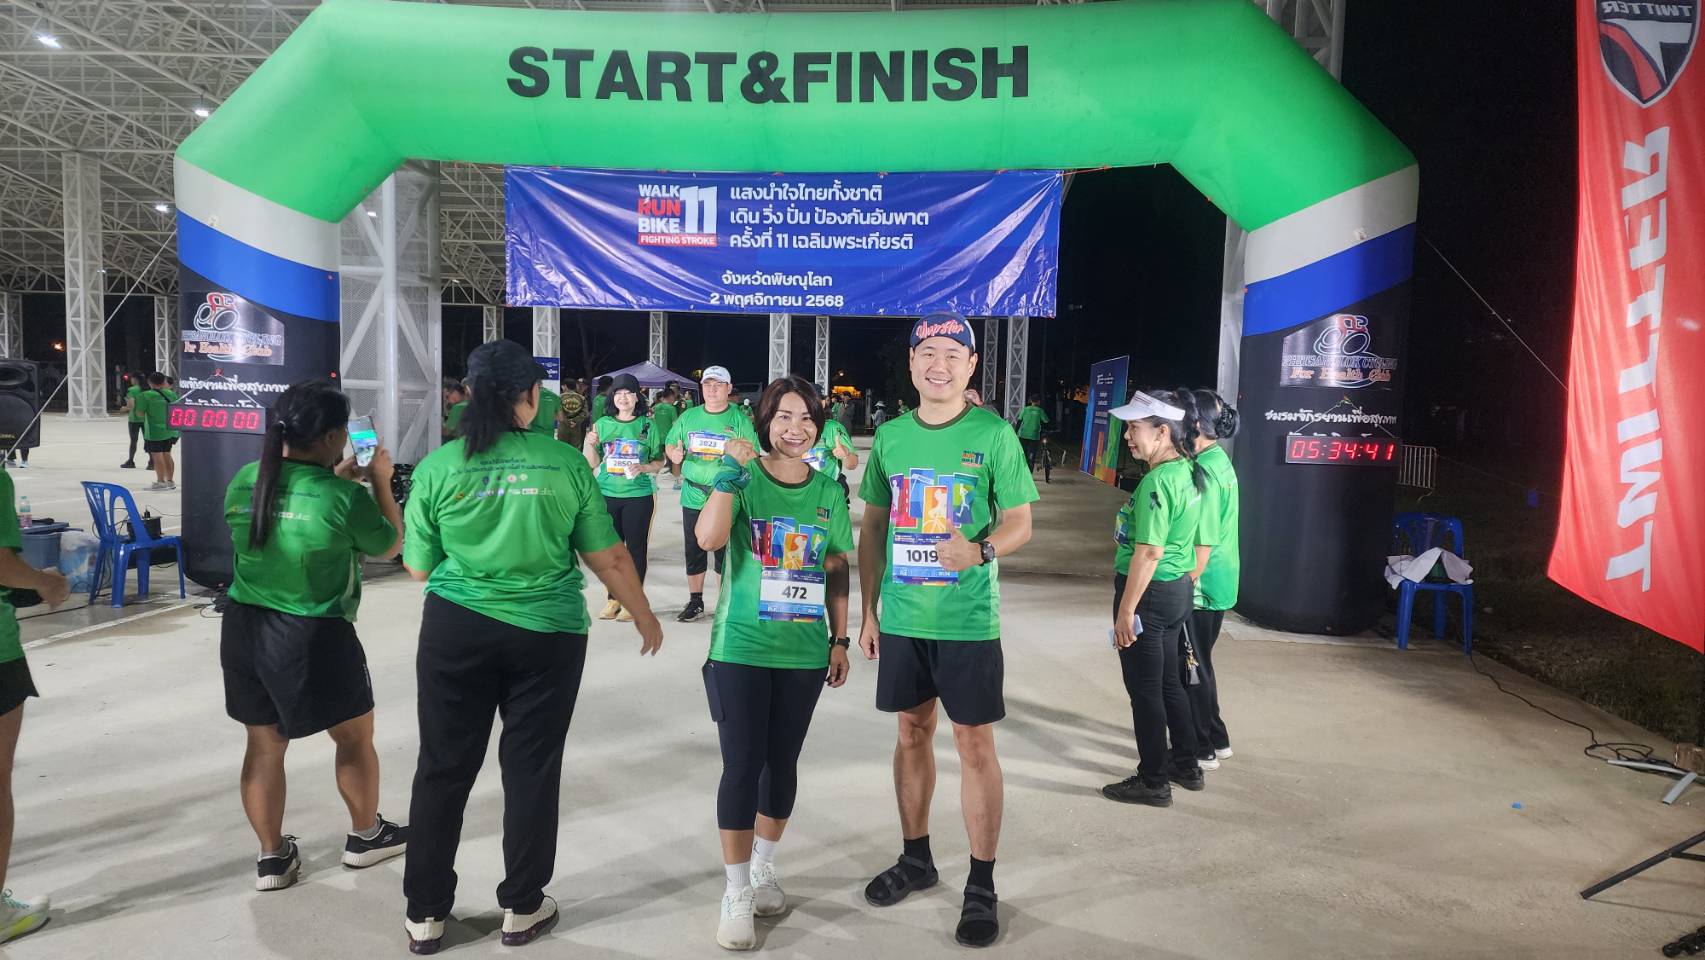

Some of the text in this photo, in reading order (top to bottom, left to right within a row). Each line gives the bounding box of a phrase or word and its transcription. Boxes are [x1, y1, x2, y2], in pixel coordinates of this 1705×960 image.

[506, 46, 1029, 104] START&FINISH
[638, 184, 680, 197] WALK
[730, 180, 882, 201] แสงนำใจไทยทั้งชาติ
[638, 198, 680, 216] RUN
[680, 186, 718, 234] 11
[730, 203, 929, 226] เดิน วิ่ง ปั่น ป้องกันอัมพาต
[638, 218, 680, 233] BIKE
[640, 236, 715, 245] FIGHTING STROKE
[730, 226, 913, 250] ครั้งที่ 11 เฉลิมพระเกียรติ
[722, 270, 832, 290] จังหวัดพิษณุโลก
[710, 293, 844, 308] 2 พฤศจิกายน 2568
[1292, 440, 1395, 460] 05:34:41
[906, 549, 939, 563] 1019
[782, 586, 807, 600] 472
